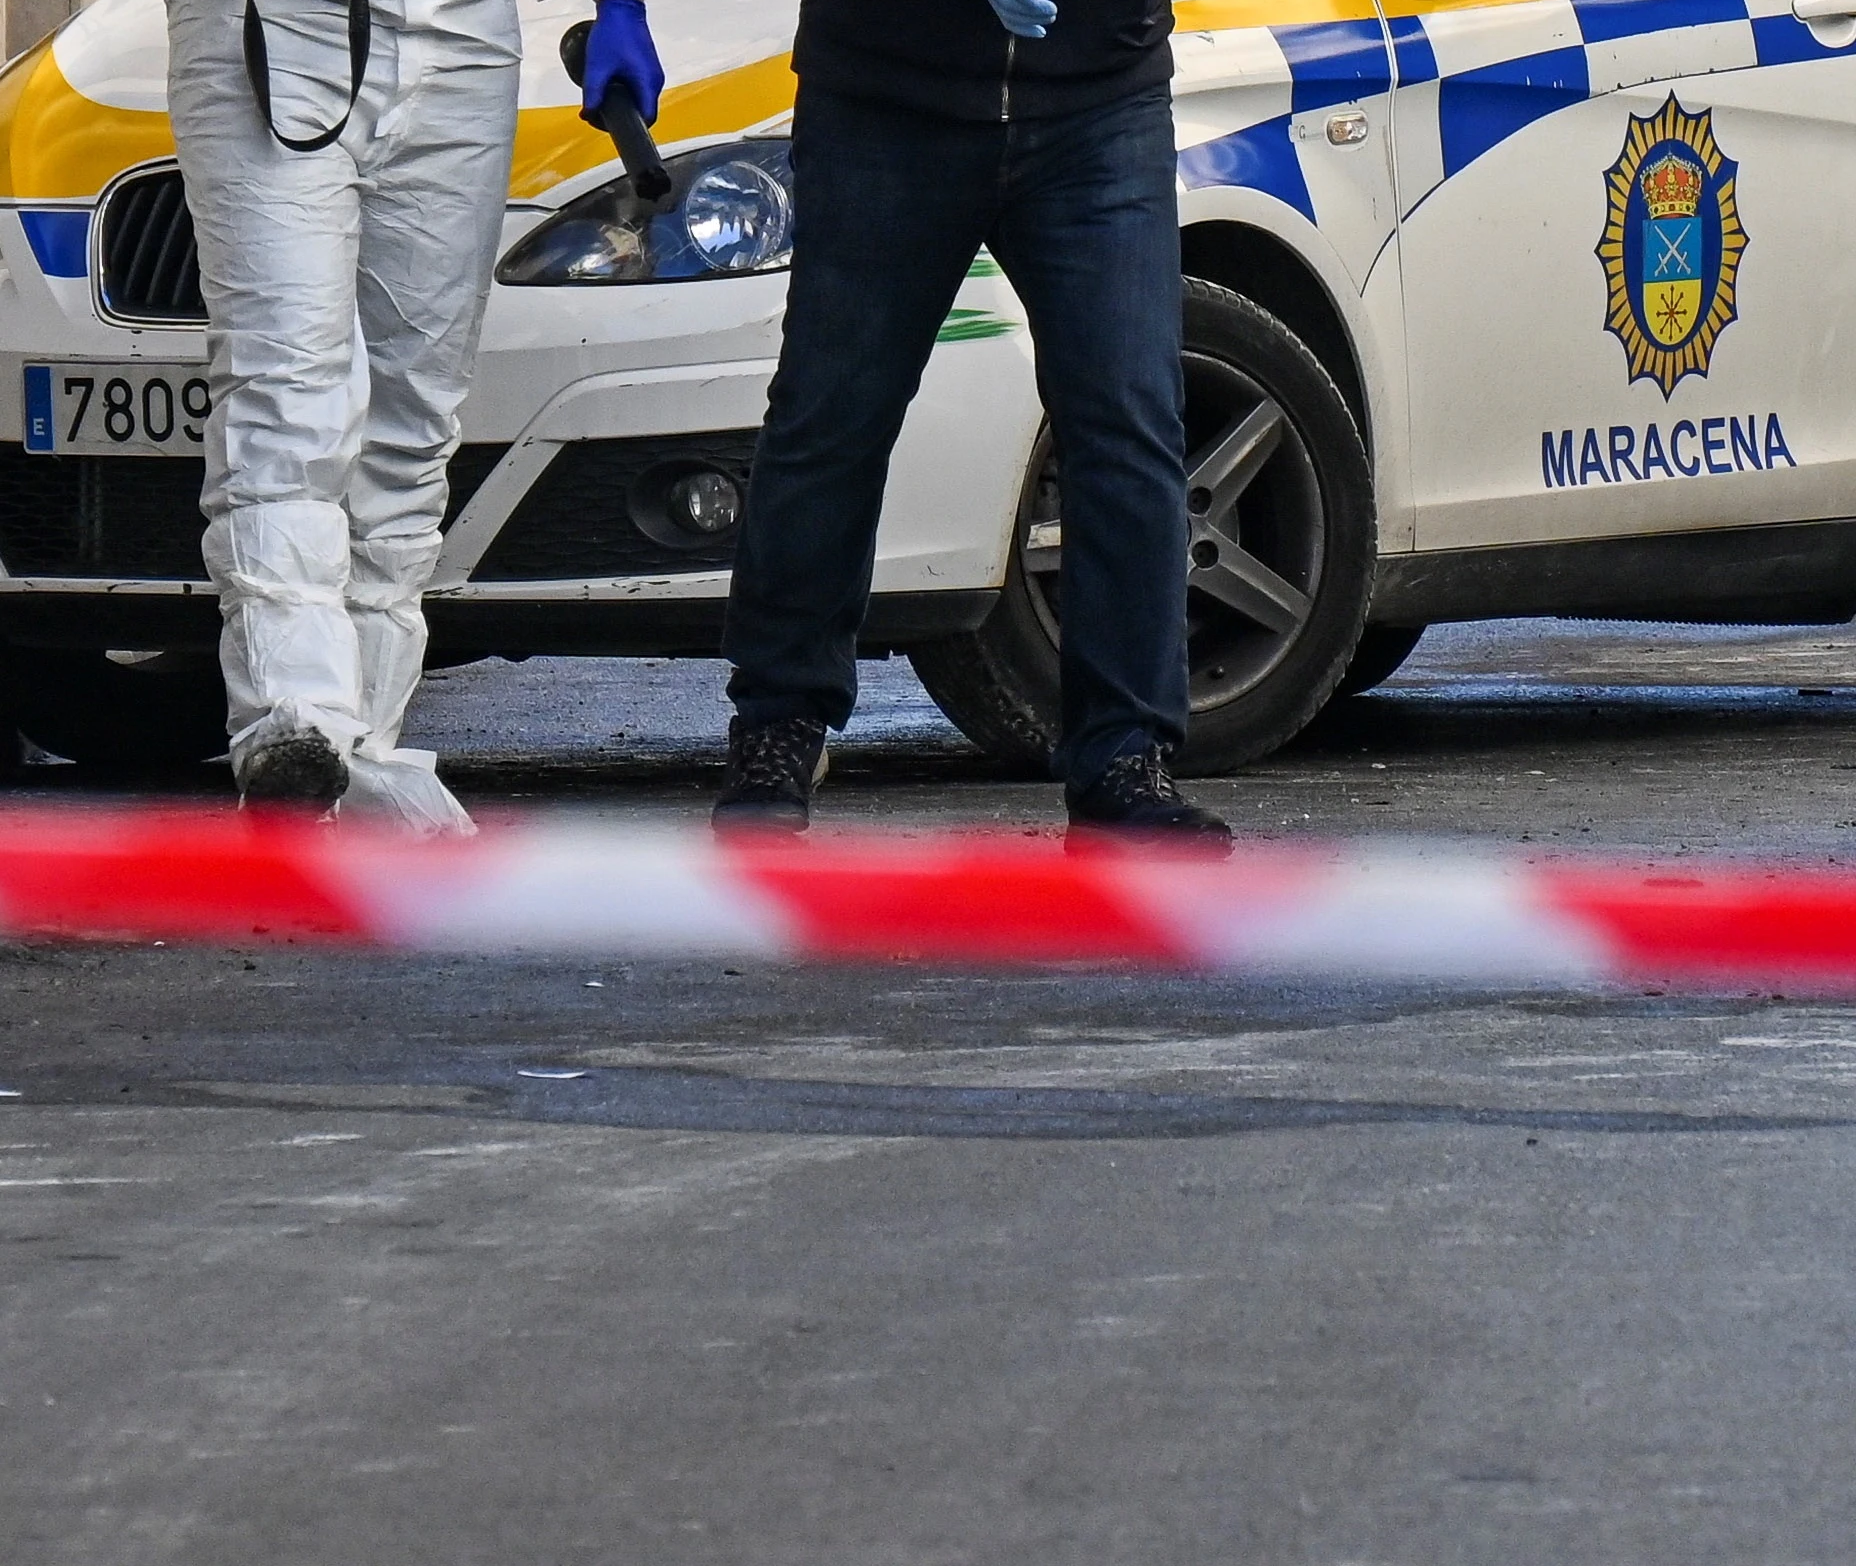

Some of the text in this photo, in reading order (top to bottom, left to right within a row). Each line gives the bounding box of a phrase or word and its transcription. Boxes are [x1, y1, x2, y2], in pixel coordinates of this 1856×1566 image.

[32, 377, 212, 443] E 7809
[1541, 412, 1798, 489] MARACENA
